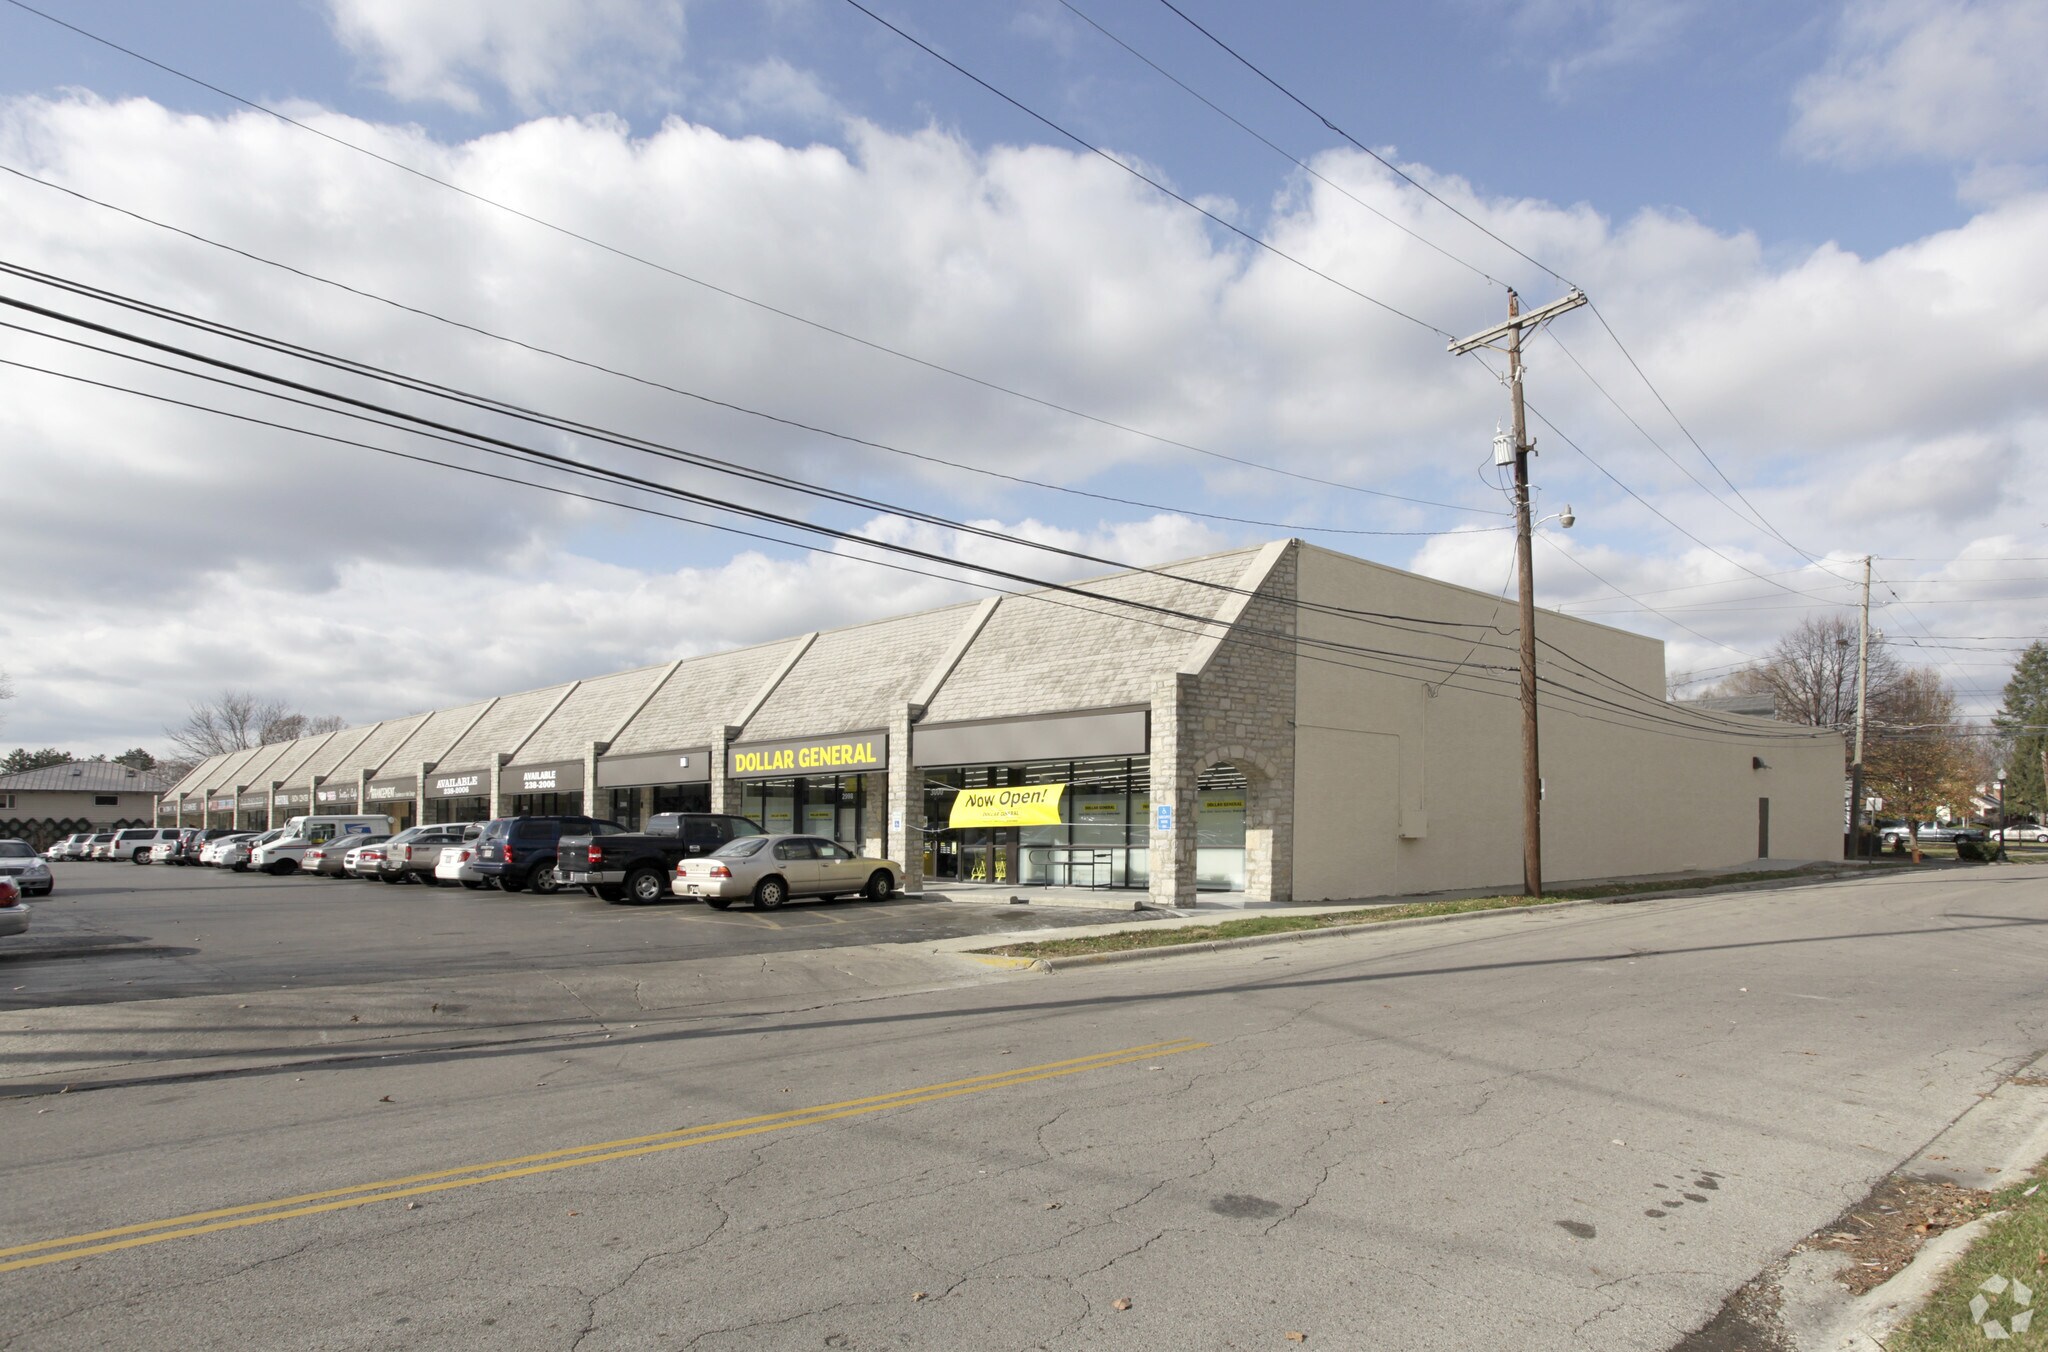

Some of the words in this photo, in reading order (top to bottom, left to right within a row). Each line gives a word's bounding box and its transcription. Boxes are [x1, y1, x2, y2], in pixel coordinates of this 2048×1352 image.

[735, 750, 794, 772] DOLLAR
[799, 742, 877, 768] GENERAL
[523, 771, 557, 780] AVAILABLE
[436, 776, 478, 788] AVAILABLE
[524, 780, 556, 789] 238-2006
[965, 794, 995, 808] Now
[999, 789, 1048, 807] Open!
